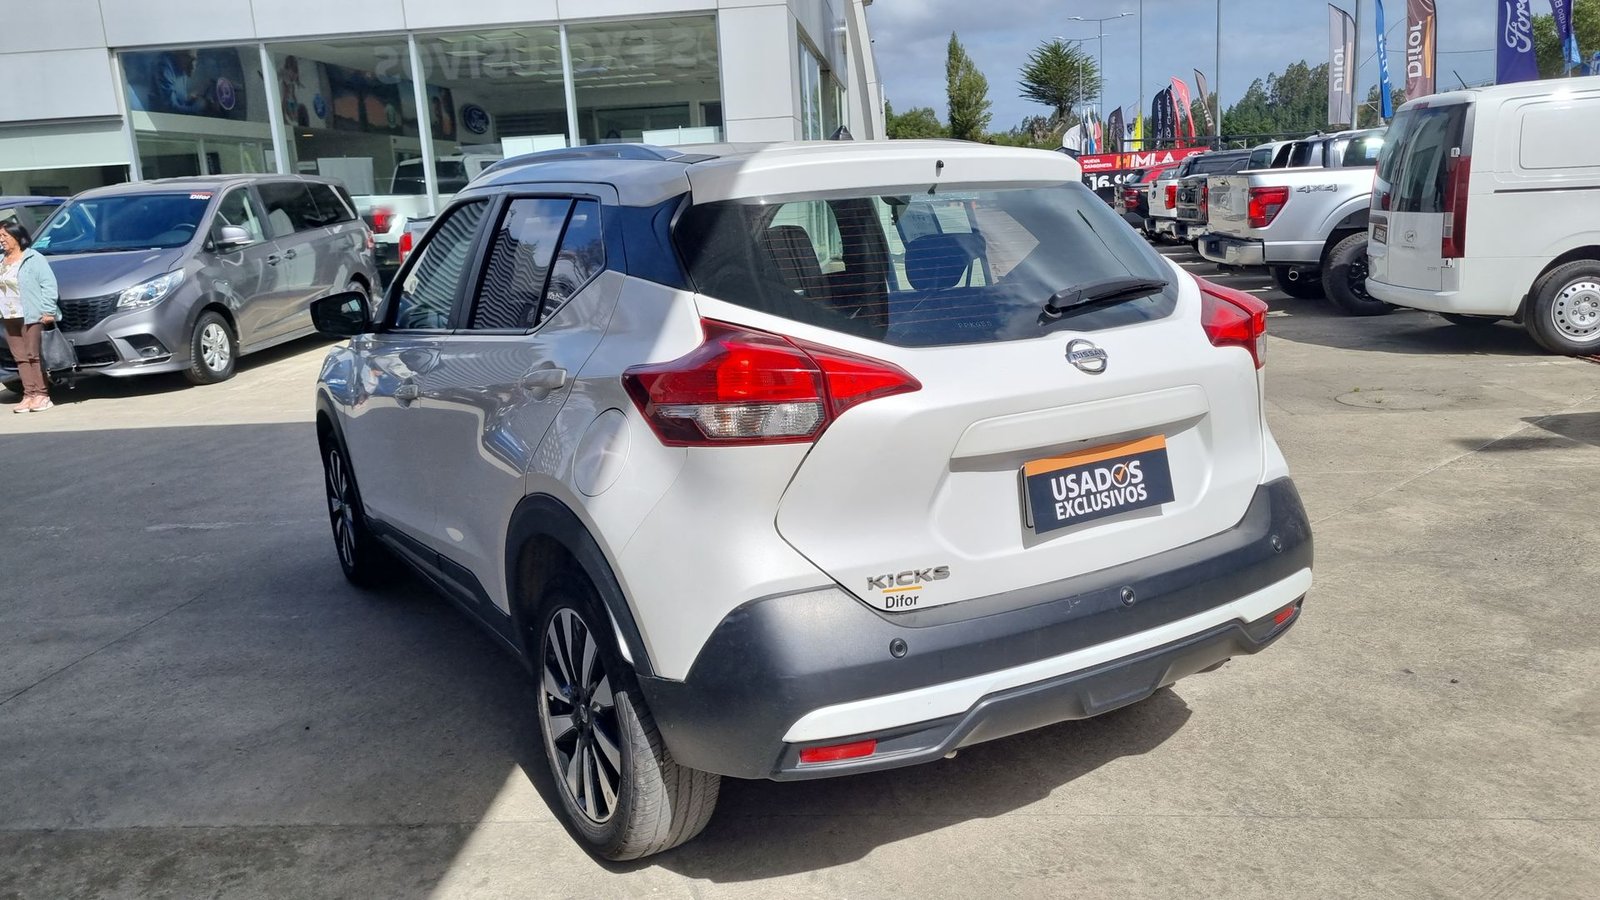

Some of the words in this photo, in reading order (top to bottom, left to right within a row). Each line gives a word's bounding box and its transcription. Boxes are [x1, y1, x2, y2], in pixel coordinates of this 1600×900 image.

[1505, 0, 1531, 53] For
[1407, 20, 1422, 78] Difor
[1115, 152, 1175, 169] HIMLA
[1072, 349, 1107, 361] NISSAN
[1051, 460, 1144, 501] USADOS
[1055, 482, 1148, 521] EXCLUSIVOS
[866, 565, 951, 591] KICKS
[885, 594, 920, 609] Difor
